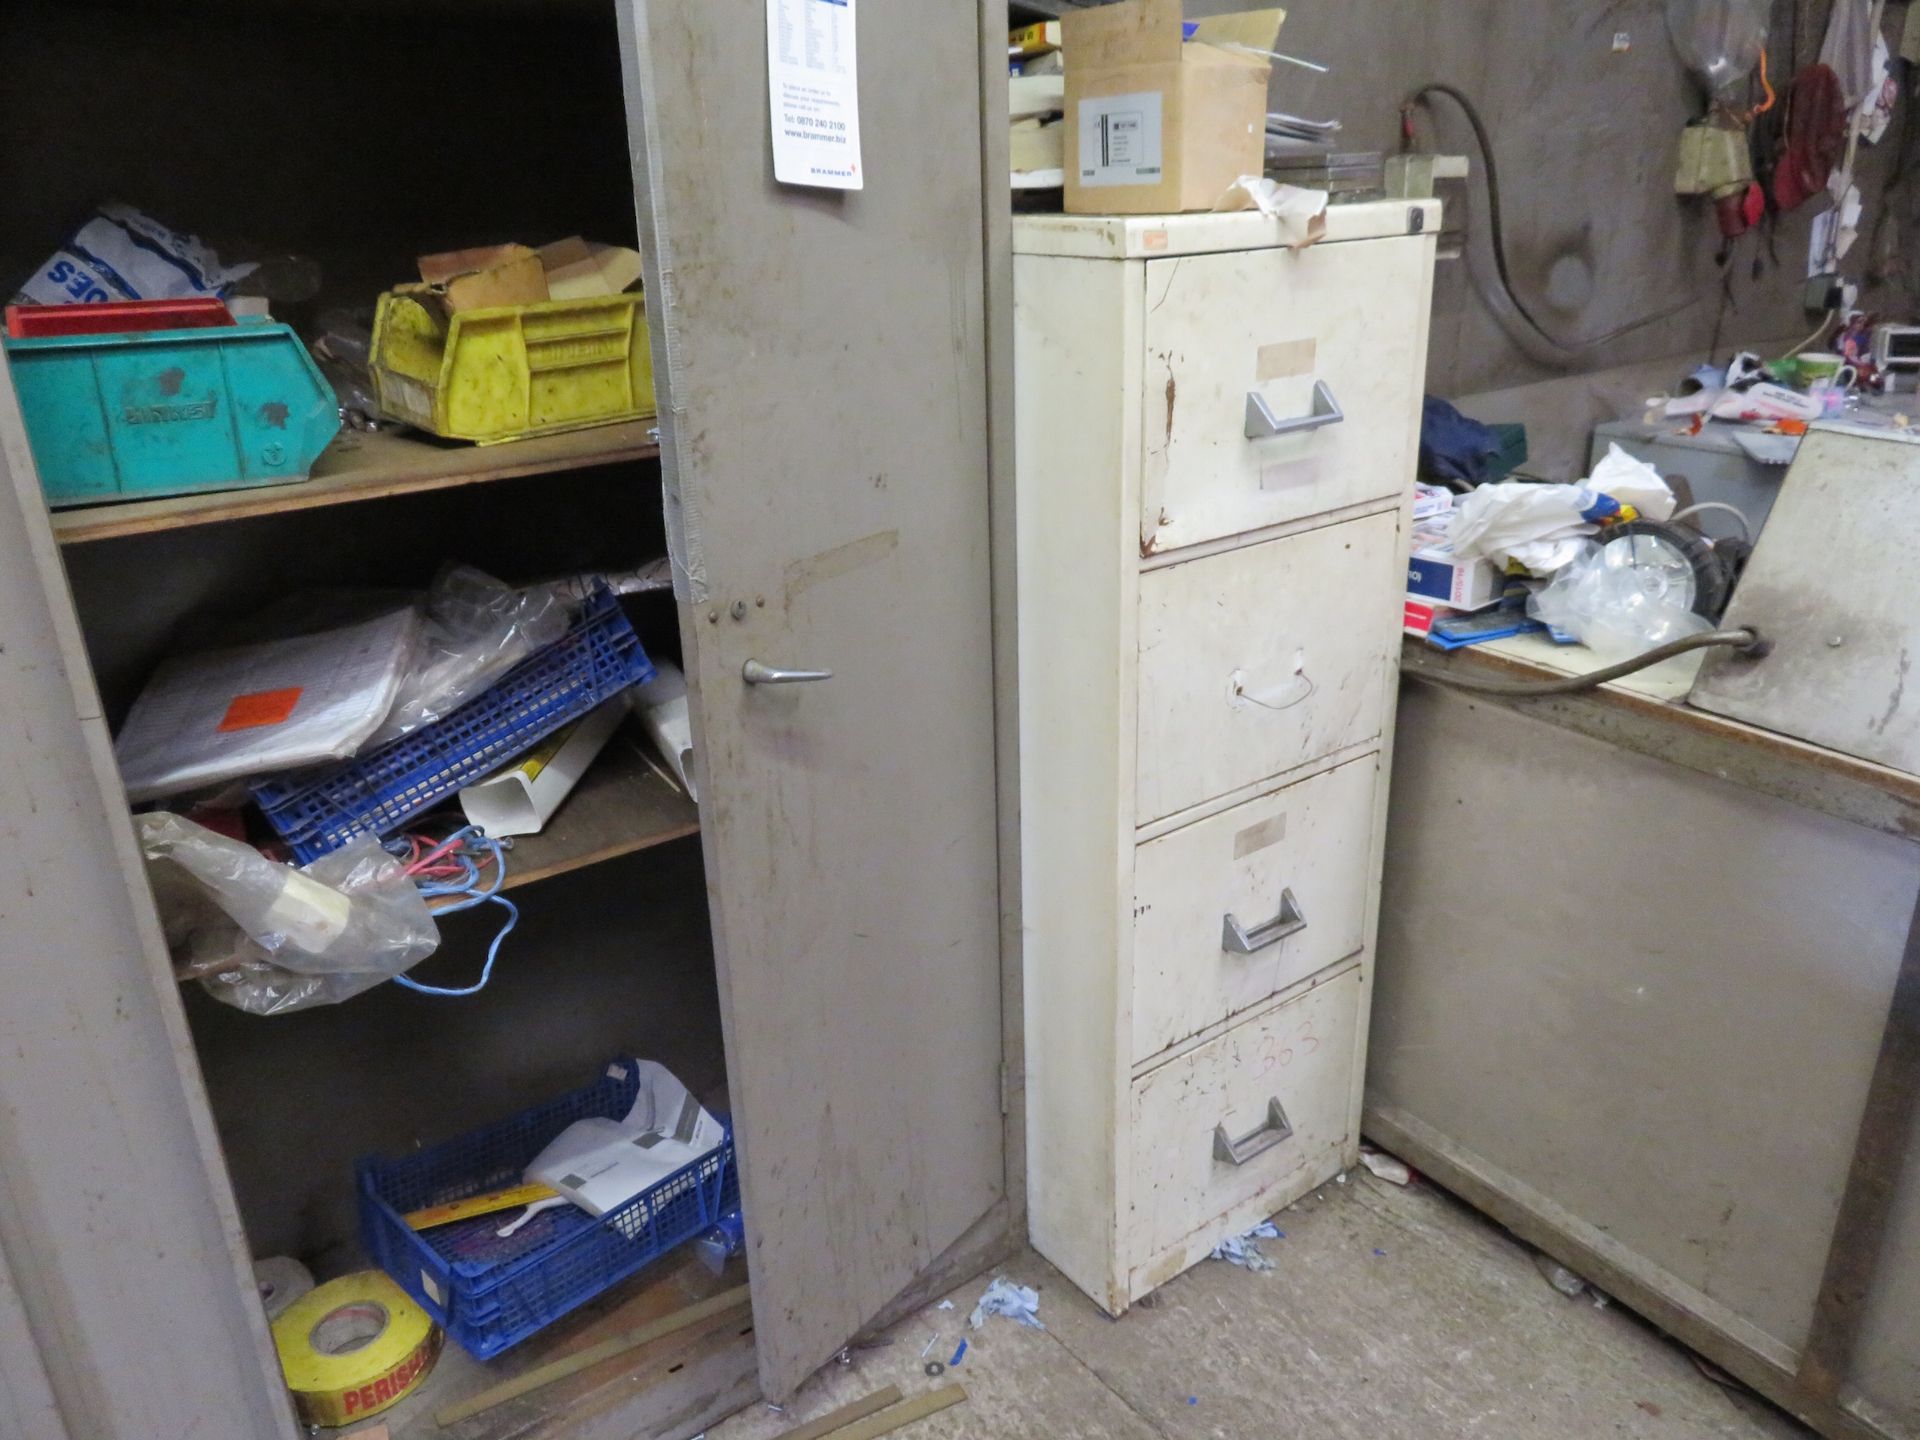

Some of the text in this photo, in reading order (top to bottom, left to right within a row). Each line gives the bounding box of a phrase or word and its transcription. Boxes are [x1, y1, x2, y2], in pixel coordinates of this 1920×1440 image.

[796, 115, 813, 126] 0870
[815, 118, 827, 128] 240
[828, 120, 846, 130] 2100
[784, 129, 847, 143] www.brammer.biz
[811, 168, 852, 177] BRAMMER
